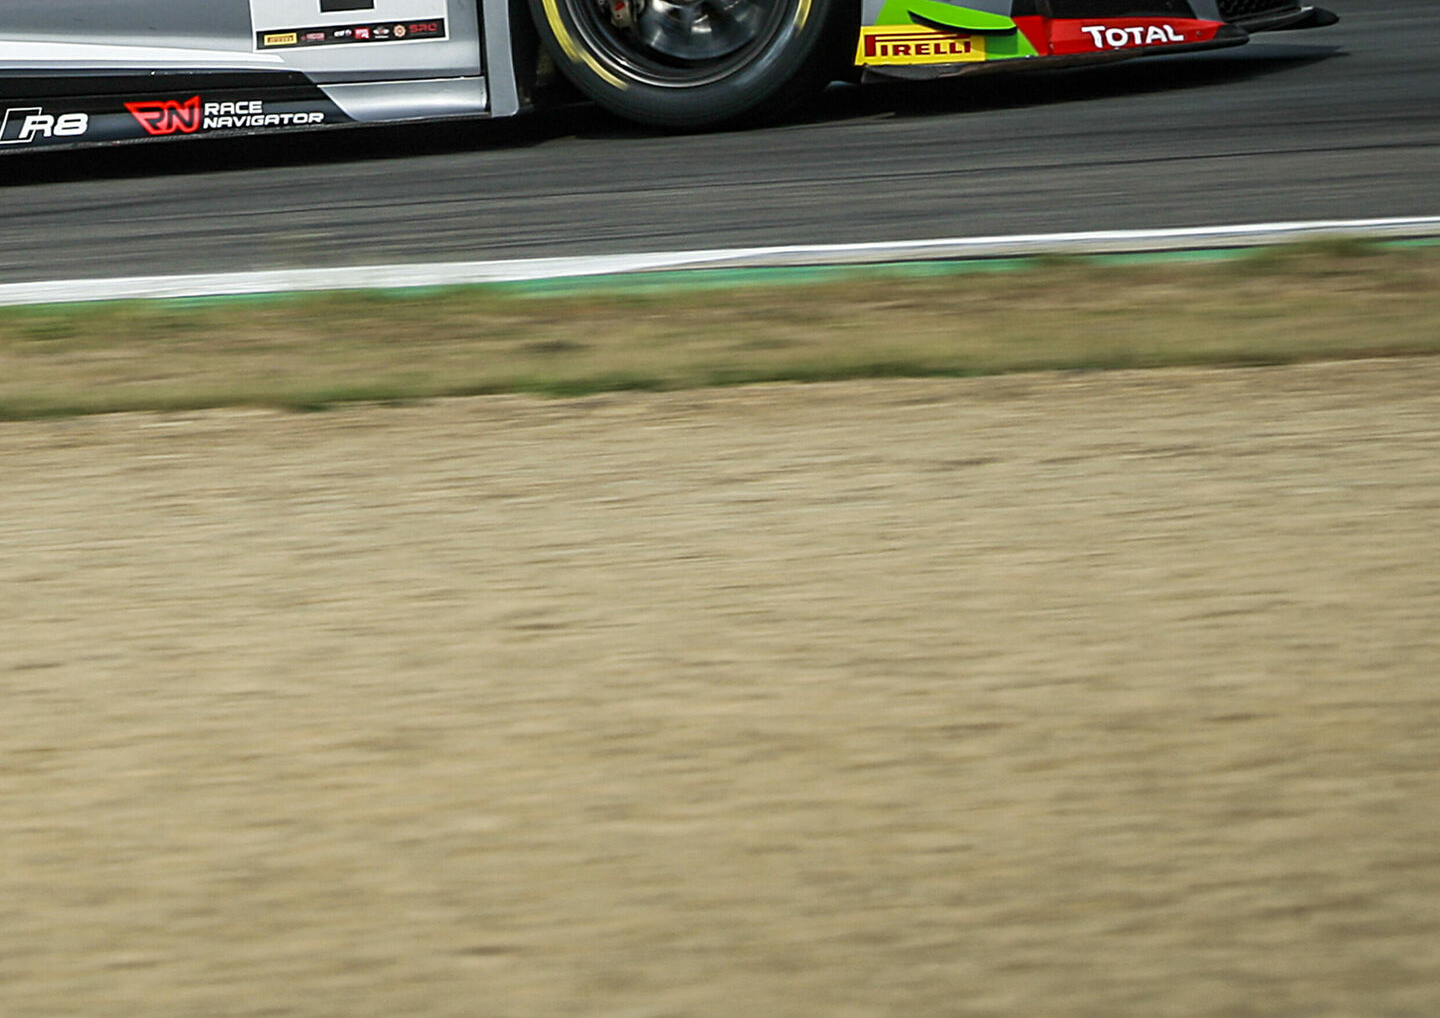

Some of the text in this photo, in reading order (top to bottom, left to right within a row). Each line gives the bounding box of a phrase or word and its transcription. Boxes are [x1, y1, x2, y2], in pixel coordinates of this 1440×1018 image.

[864, 30, 972, 57] PIRELLI
[1081, 24, 1185, 48] TOTAL
[203, 101, 263, 116] RACE
[203, 112, 325, 129] NAVIGATOR
[19, 113, 89, 138] R8
